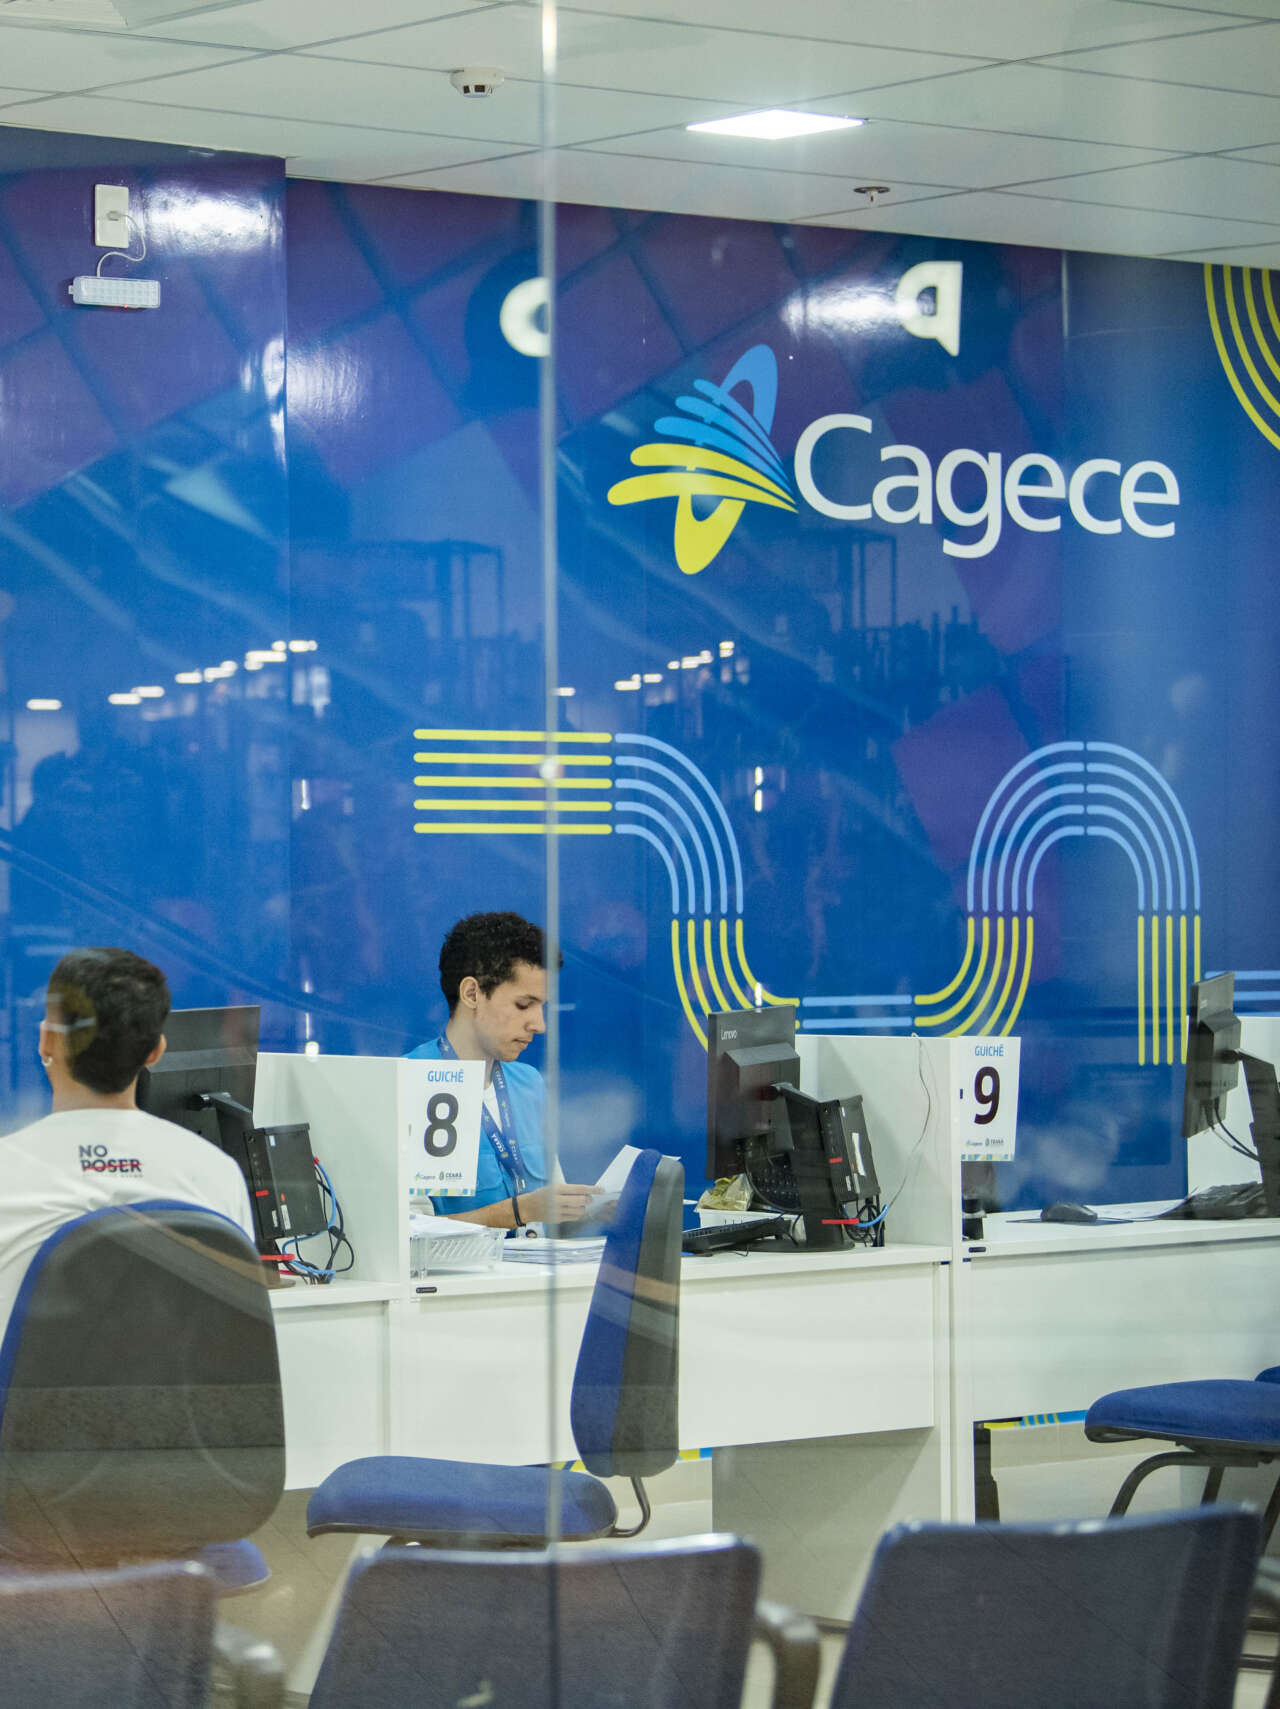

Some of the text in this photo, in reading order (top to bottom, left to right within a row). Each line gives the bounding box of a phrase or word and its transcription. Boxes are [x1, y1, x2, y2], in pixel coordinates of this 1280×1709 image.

[793, 413, 1181, 558] Cagece
[974, 1043, 1004, 1057] GUICHÊ
[427, 1068, 465, 1083] GUICHÊ
[973, 1065, 1001, 1125] 9
[423, 1092, 459, 1158] 8
[78, 1144, 109, 1158] NO
[80, 1158, 142, 1173] POSER
